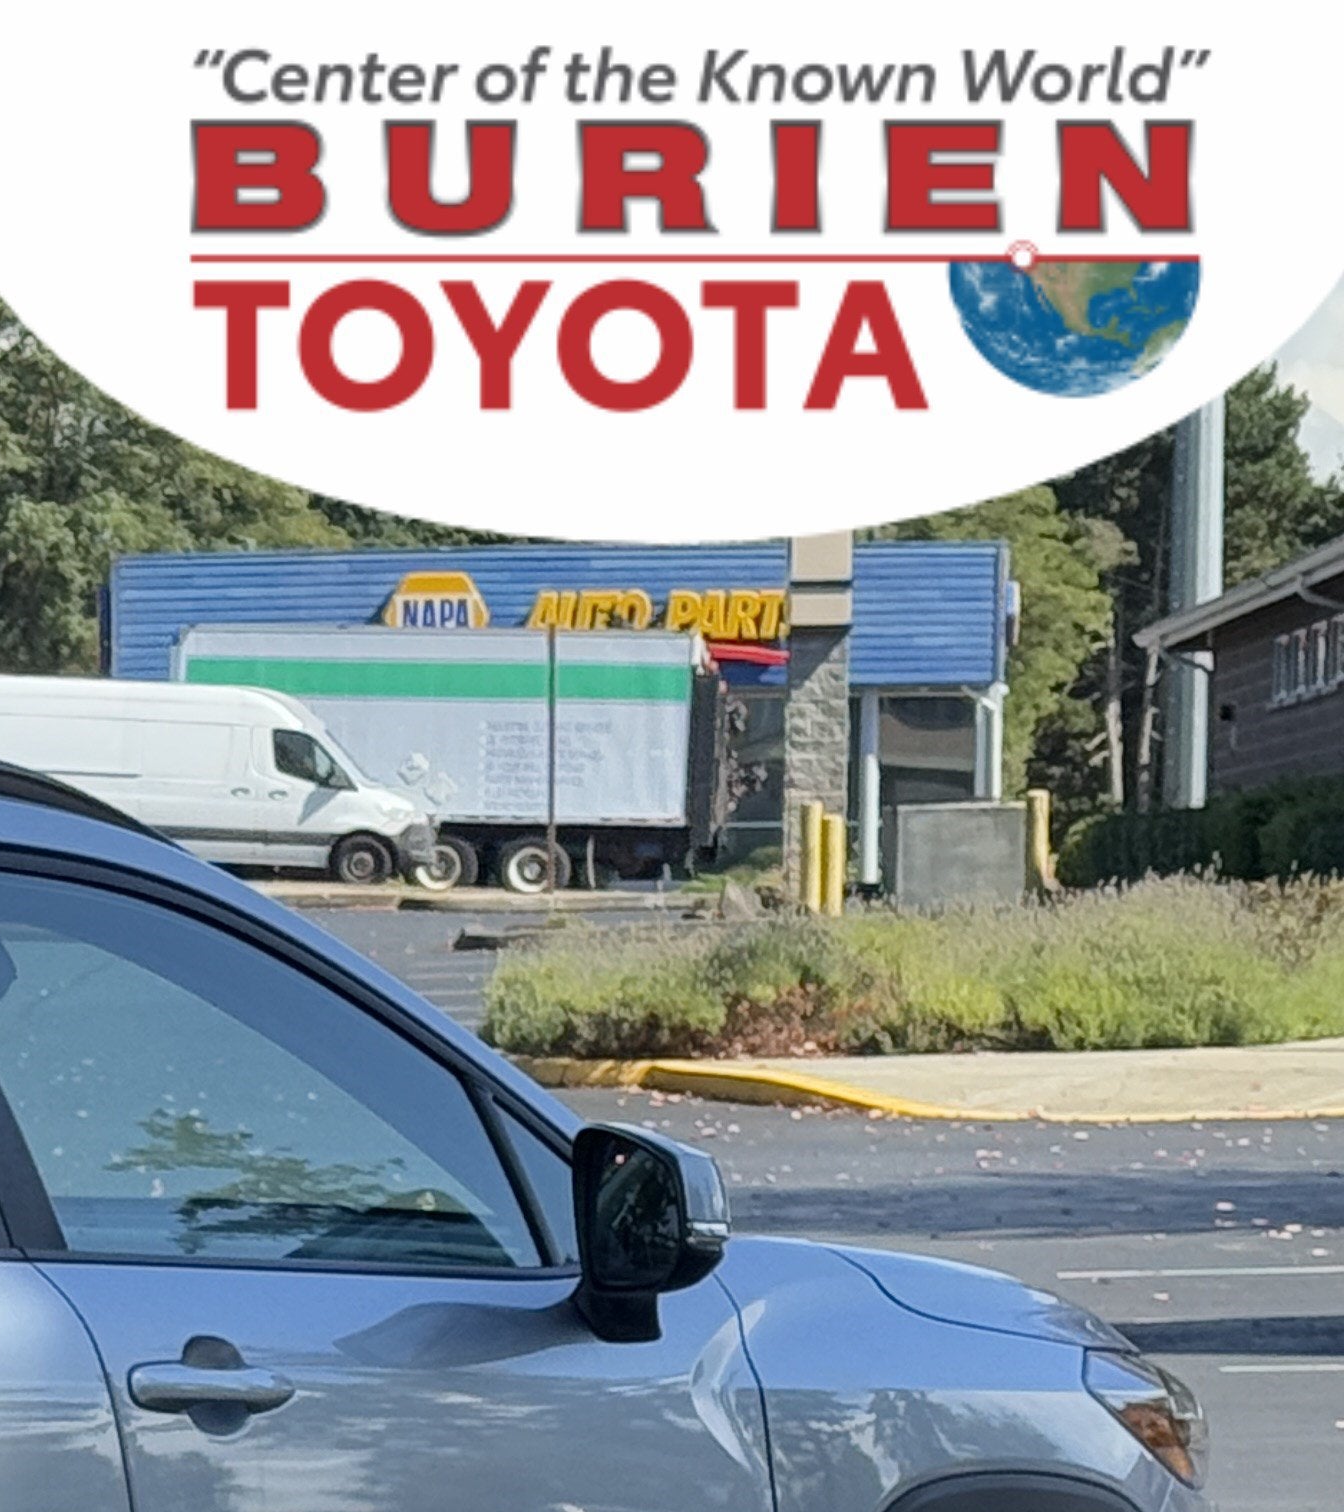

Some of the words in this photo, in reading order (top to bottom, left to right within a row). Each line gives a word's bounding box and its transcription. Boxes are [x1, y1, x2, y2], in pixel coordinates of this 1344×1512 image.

[402, 598, 469, 628] NAPA
[525, 588, 654, 630] AUTO
[665, 588, 792, 640] PART
